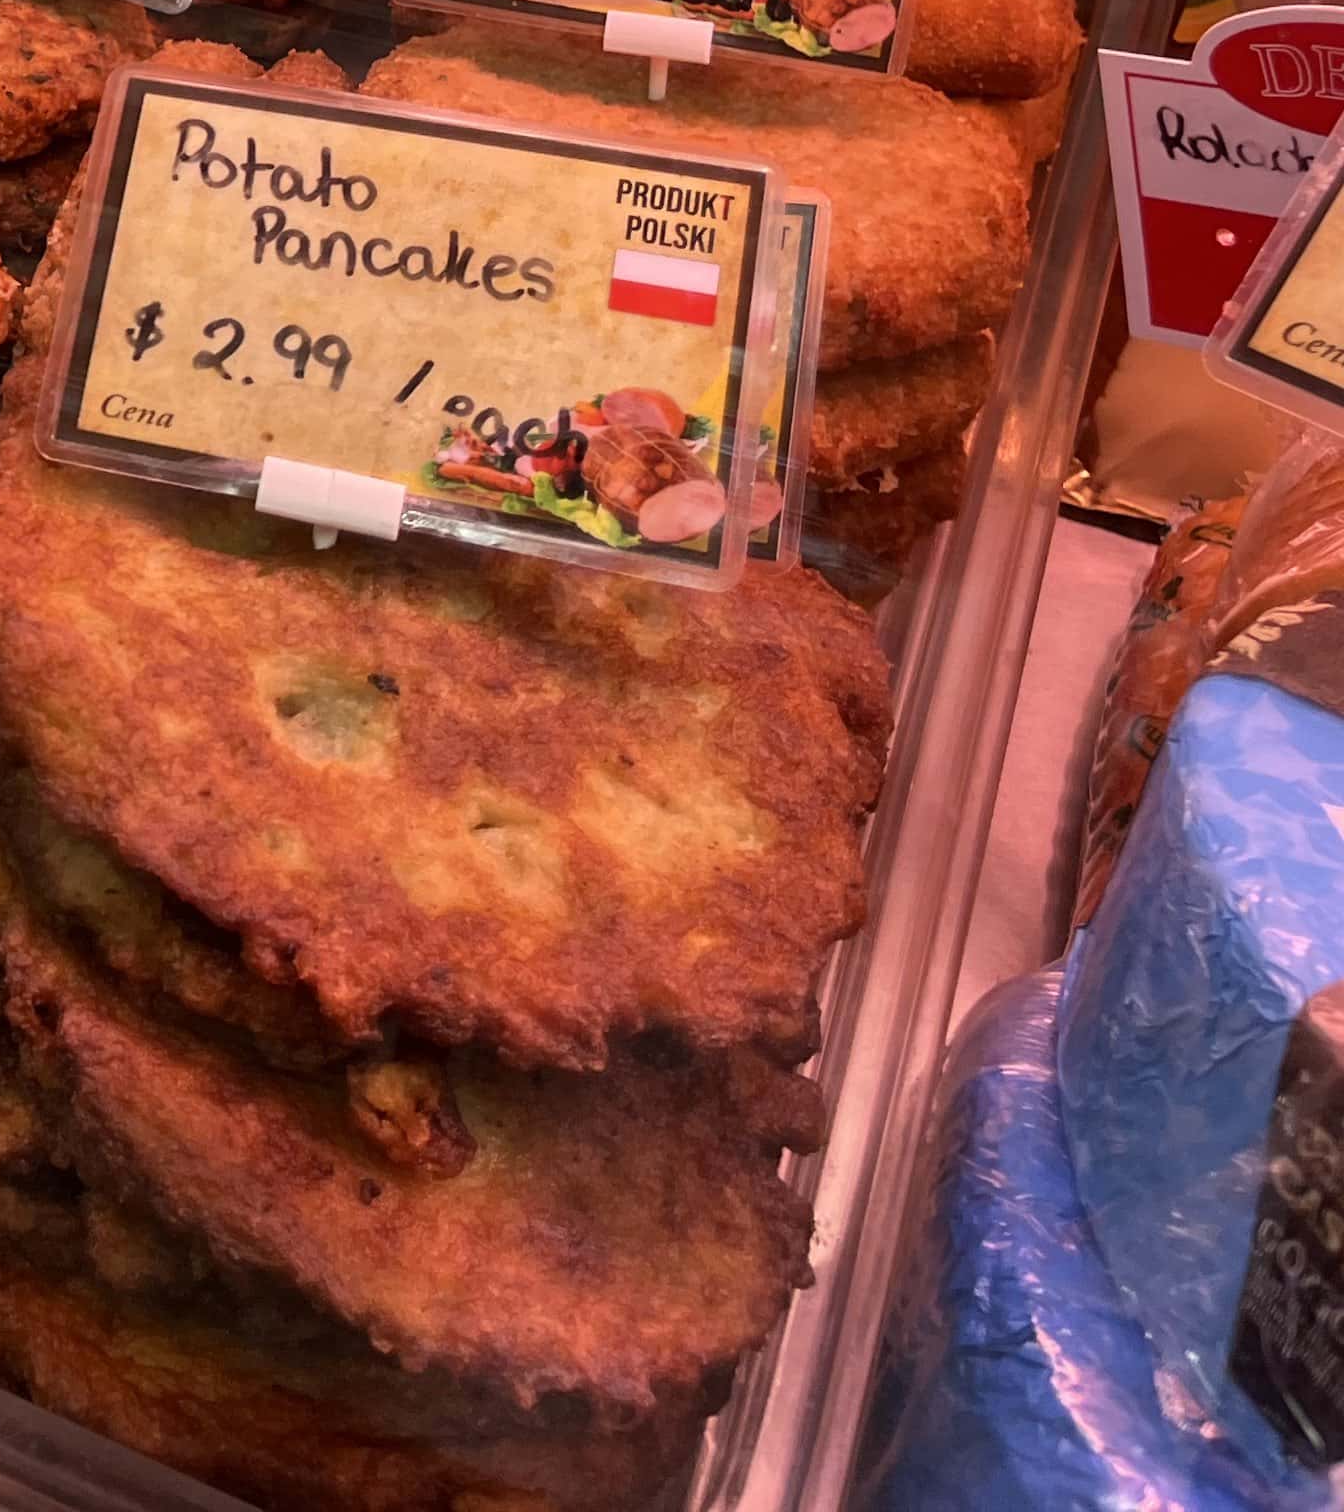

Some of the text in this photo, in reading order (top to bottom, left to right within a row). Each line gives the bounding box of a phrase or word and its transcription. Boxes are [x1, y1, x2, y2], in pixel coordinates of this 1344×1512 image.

[171, 118, 378, 213] Potato
[615, 178, 737, 224] PRODUKT
[623, 214, 718, 256] POLSKI
[252, 204, 558, 305] Pancakes
[124, 300, 165, 362] $
[192, 316, 354, 394] 2.99
[99, 391, 176, 431] Cena
